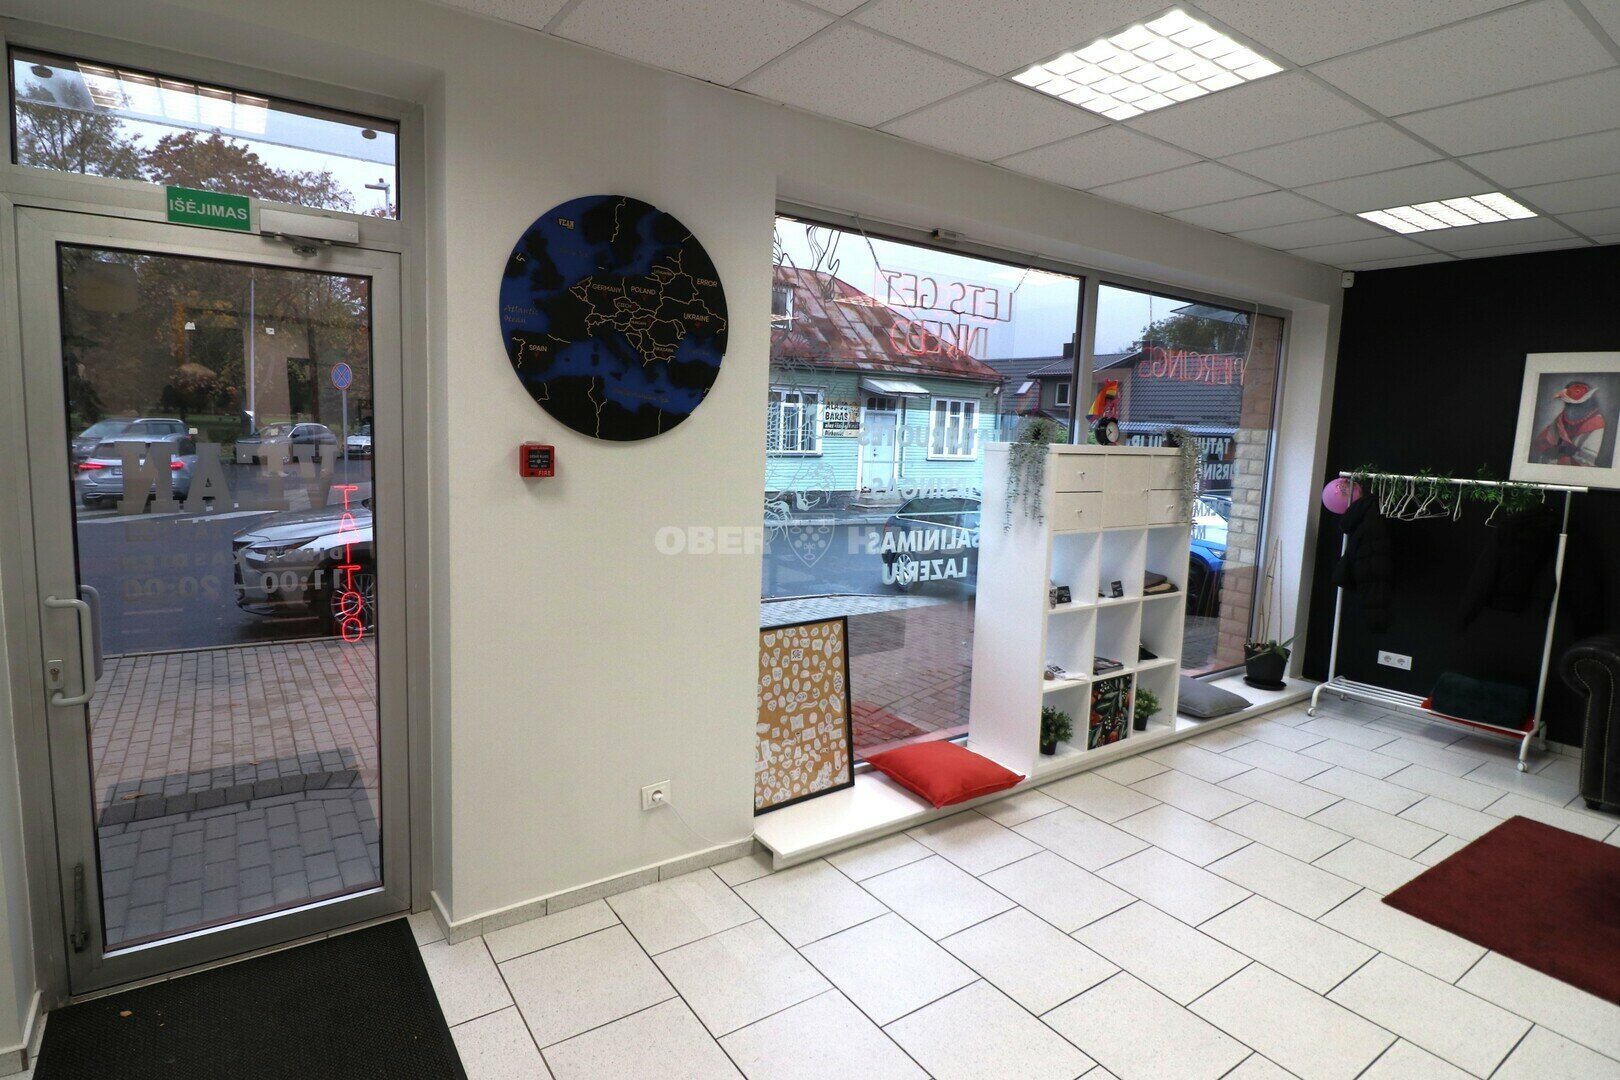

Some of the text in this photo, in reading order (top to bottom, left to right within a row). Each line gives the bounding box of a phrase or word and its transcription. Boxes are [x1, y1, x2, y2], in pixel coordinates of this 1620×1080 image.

[169, 197, 248, 220] IŠĖJIMAS
[697, 278, 718, 287] ERROR
[592, 284, 622, 293] GERMANY
[631, 286, 656, 296] POLAND
[683, 313, 710, 322] UKRAINE
[333, 485, 363, 642] TATTOO
